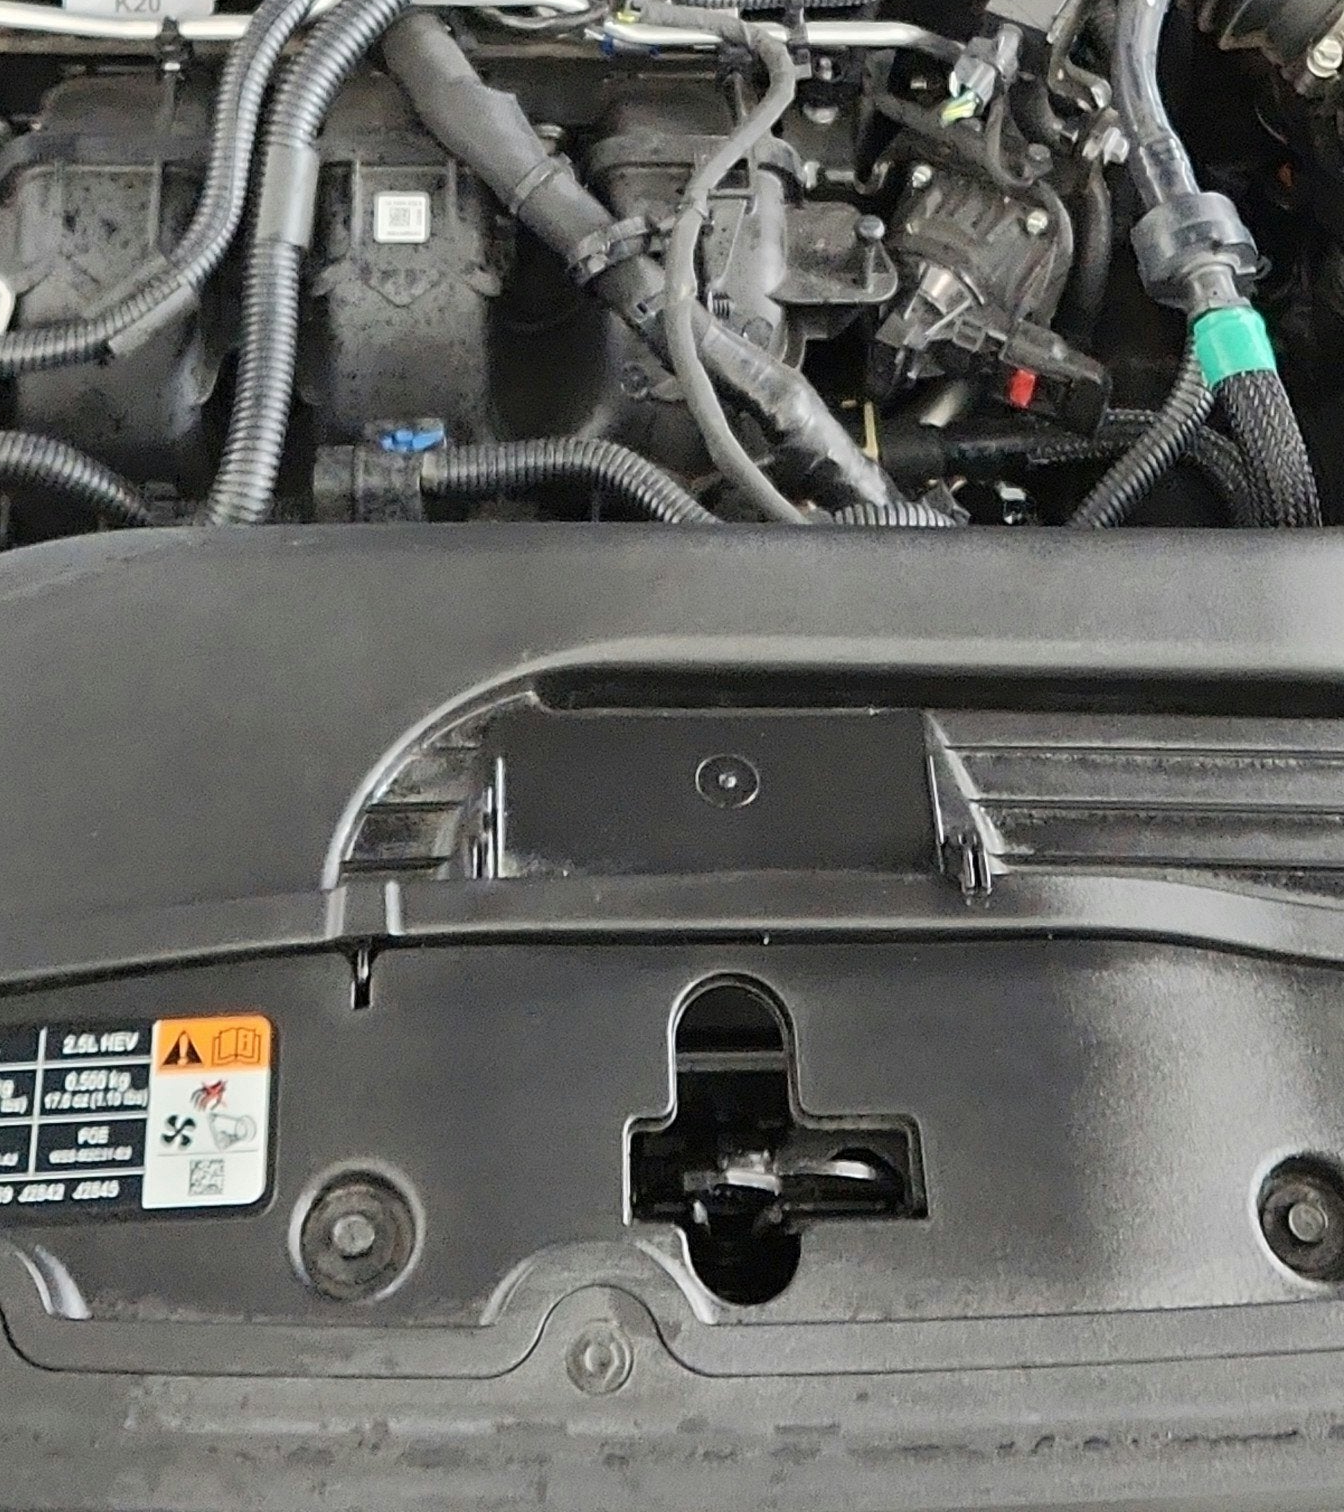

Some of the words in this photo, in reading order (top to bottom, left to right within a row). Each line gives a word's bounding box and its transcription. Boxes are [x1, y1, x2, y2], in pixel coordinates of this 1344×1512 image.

[62, 1034, 99, 1054] 2.5L
[100, 1031, 139, 1052] HEV
[109, 1069, 131, 1092] kg
